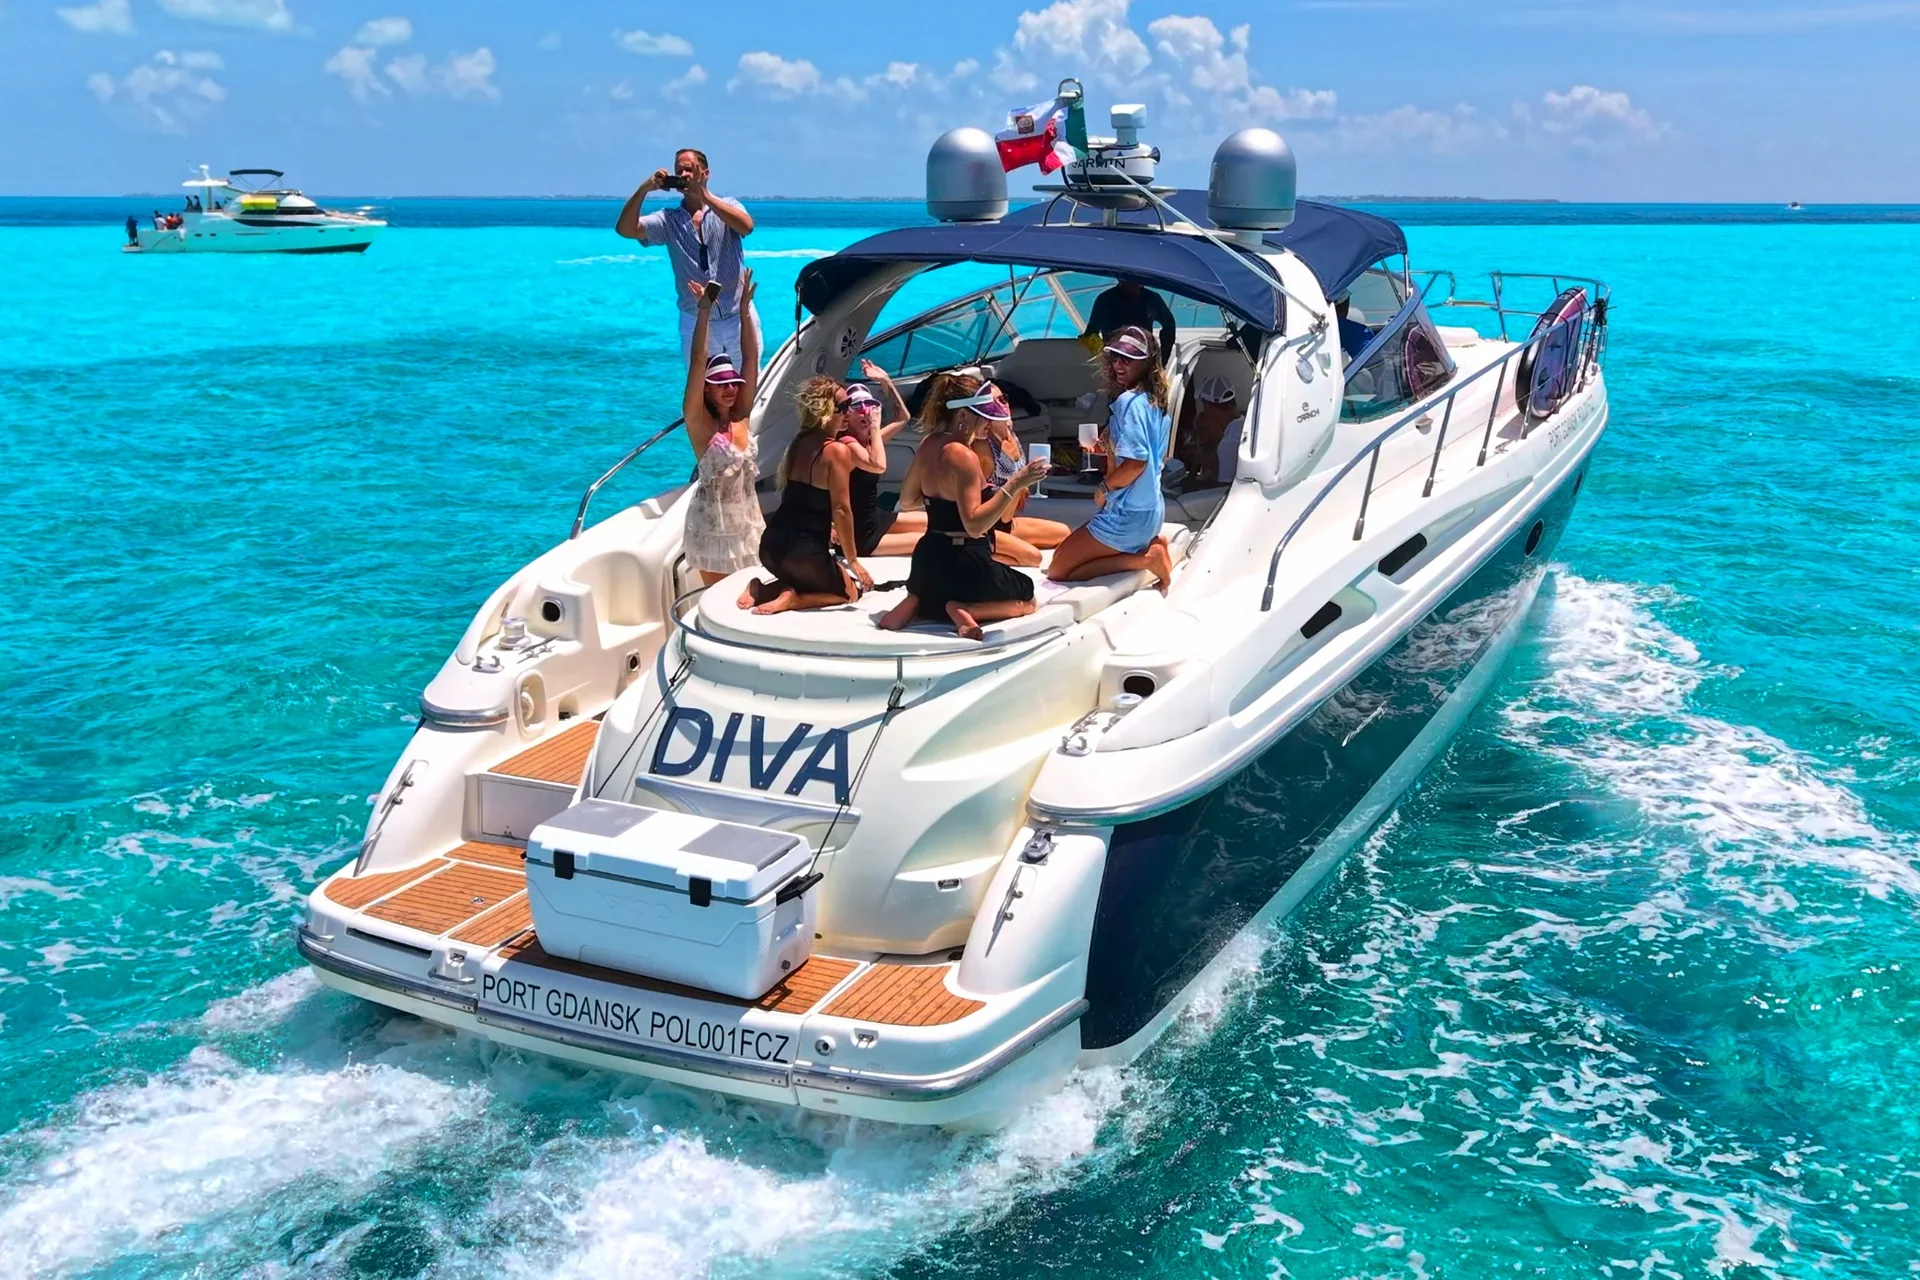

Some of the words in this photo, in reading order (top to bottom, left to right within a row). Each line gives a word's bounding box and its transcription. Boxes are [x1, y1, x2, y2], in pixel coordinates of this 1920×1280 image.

[648, 706, 851, 806] DIVA
[482, 974, 541, 1011] PORT
[545, 988, 641, 1035] GDANSK
[650, 1010, 790, 1064] POL001FCZ
